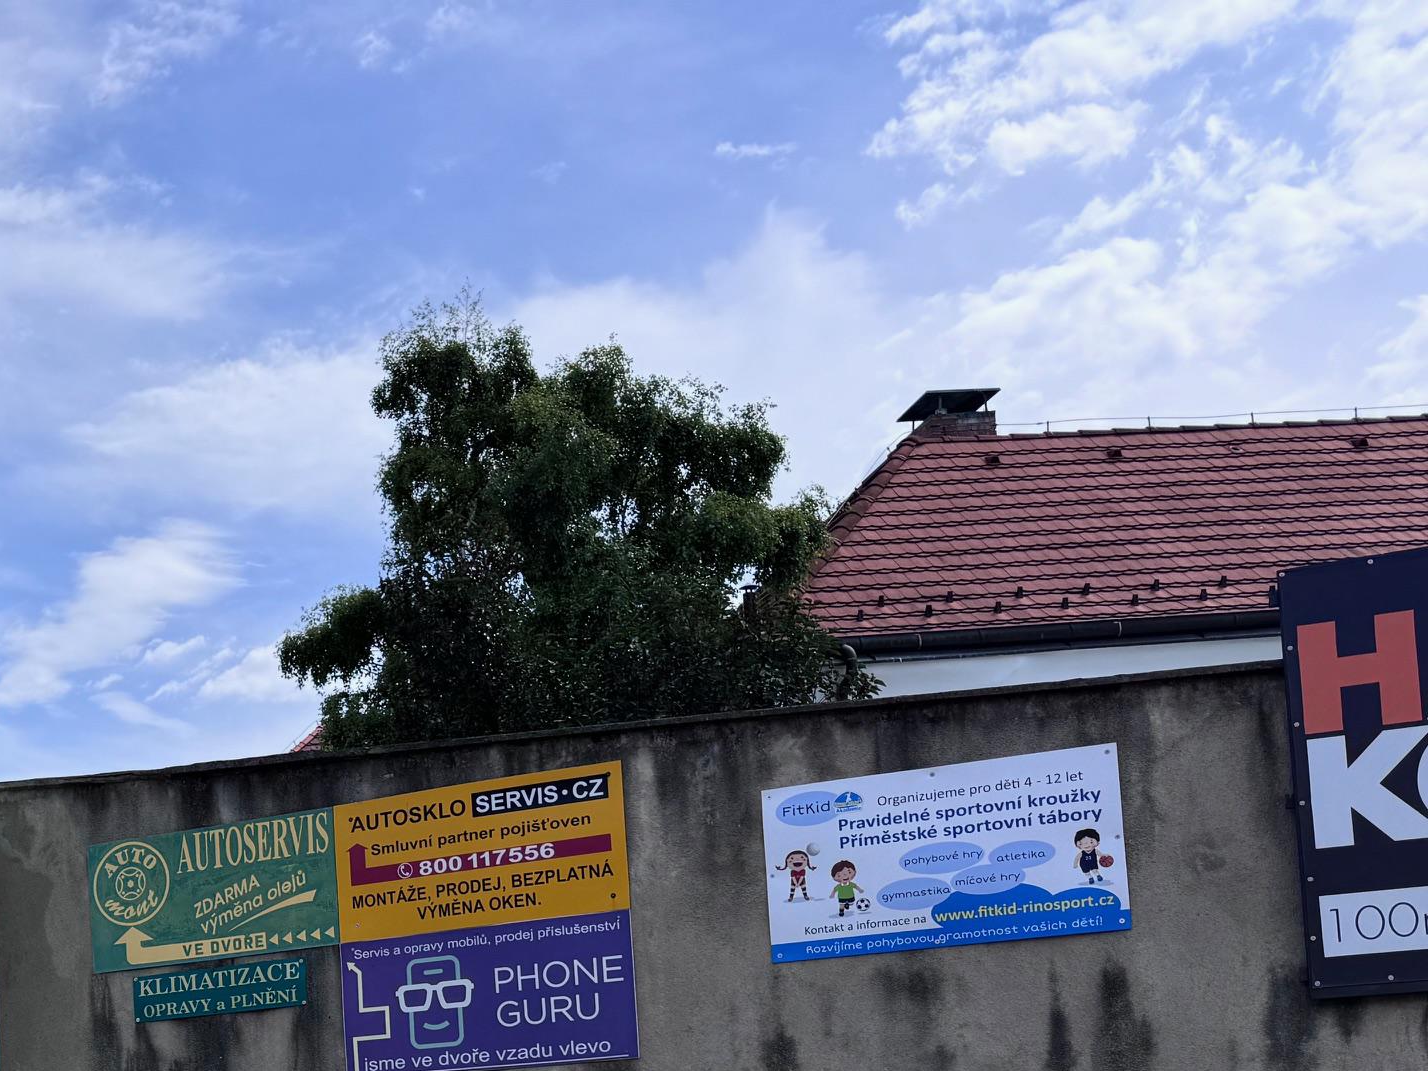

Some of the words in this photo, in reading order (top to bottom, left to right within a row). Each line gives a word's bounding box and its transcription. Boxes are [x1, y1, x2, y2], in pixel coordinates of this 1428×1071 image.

[877, 789, 966, 807] Organizujeme
[969, 785, 991, 796] pro
[994, 777, 1020, 791] děti
[1024, 777, 1032, 787] 4
[1045, 774, 1062, 785] 12
[1065, 771, 1084, 783] let
[1306, 723, 1428, 849] K
[351, 800, 466, 833] AUTOSKLO
[781, 800, 831, 817] FitKid
[838, 807, 931, 832] Pravidelné
[935, 799, 1022, 821] sportovní
[1027, 788, 1102, 810] kroužky
[176, 811, 330, 875] AUTOSERVIS
[371, 833, 434, 856] Smluvní
[437, 828, 495, 848] partner
[500, 814, 591, 838] pojišťoven
[839, 826, 938, 849] Příměstské
[943, 816, 1033, 838] sportovní
[1038, 808, 1103, 828] tábory
[104, 847, 157, 879] AUTO
[419, 855, 462, 876] 800
[467, 842, 555, 869] 117556
[904, 850, 959, 867] pohybové
[963, 849, 984, 860] hry
[996, 849, 1046, 863] atletika
[194, 874, 260, 918] ZDARMA
[352, 886, 432, 909] MONTÁŽE,
[436, 876, 507, 899] PRODEJ,
[511, 859, 614, 889] BEZPLATNÁ
[881, 886, 951, 903] gymnastika
[955, 874, 997, 887] míčové
[1000, 872, 1021, 882] hry
[201, 897, 263, 935] výměna
[268, 870, 306, 901] olejů
[417, 894, 486, 920] VÝMĚNA
[489, 891, 542, 911] OKEN.
[935, 894, 1115, 923] www.fitkid-rinosport.cz
[354, 946, 391, 960] Servis
[393, 946, 401, 955] a
[404, 939, 444, 956] opravy
[447, 933, 492, 949] mobilů,
[494, 926, 535, 945] prodej
[537, 917, 621, 939] příslušenství
[804, 923, 845, 936] Kontakt
[847, 923, 854, 931] a
[856, 918, 911, 931] informace
[913, 915, 927, 924] na
[806, 940, 863, 955] Rozvíjíme
[867, 935, 934, 950] pohybovou
[938, 925, 1018, 944] gramotnost
[1022, 920, 1067, 932] vašich
[1071, 915, 1103, 928] dětí!
[1329, 902, 1428, 943] 100
[182, 943, 204, 957] VE
[138, 961, 301, 998] KLIMATIZACE
[493, 954, 625, 994] PHONE
[143, 998, 212, 1019] OPRAVY
[217, 1001, 226, 1011] a
[231, 984, 299, 1009] PLNĚNÍ
[496, 993, 601, 1028] GURU
[412, 1056, 433, 1067] ve
[438, 1049, 491, 1065] dvoře
[495, 1042, 553, 1060] vzadu
[558, 1039, 611, 1056] vlevo
